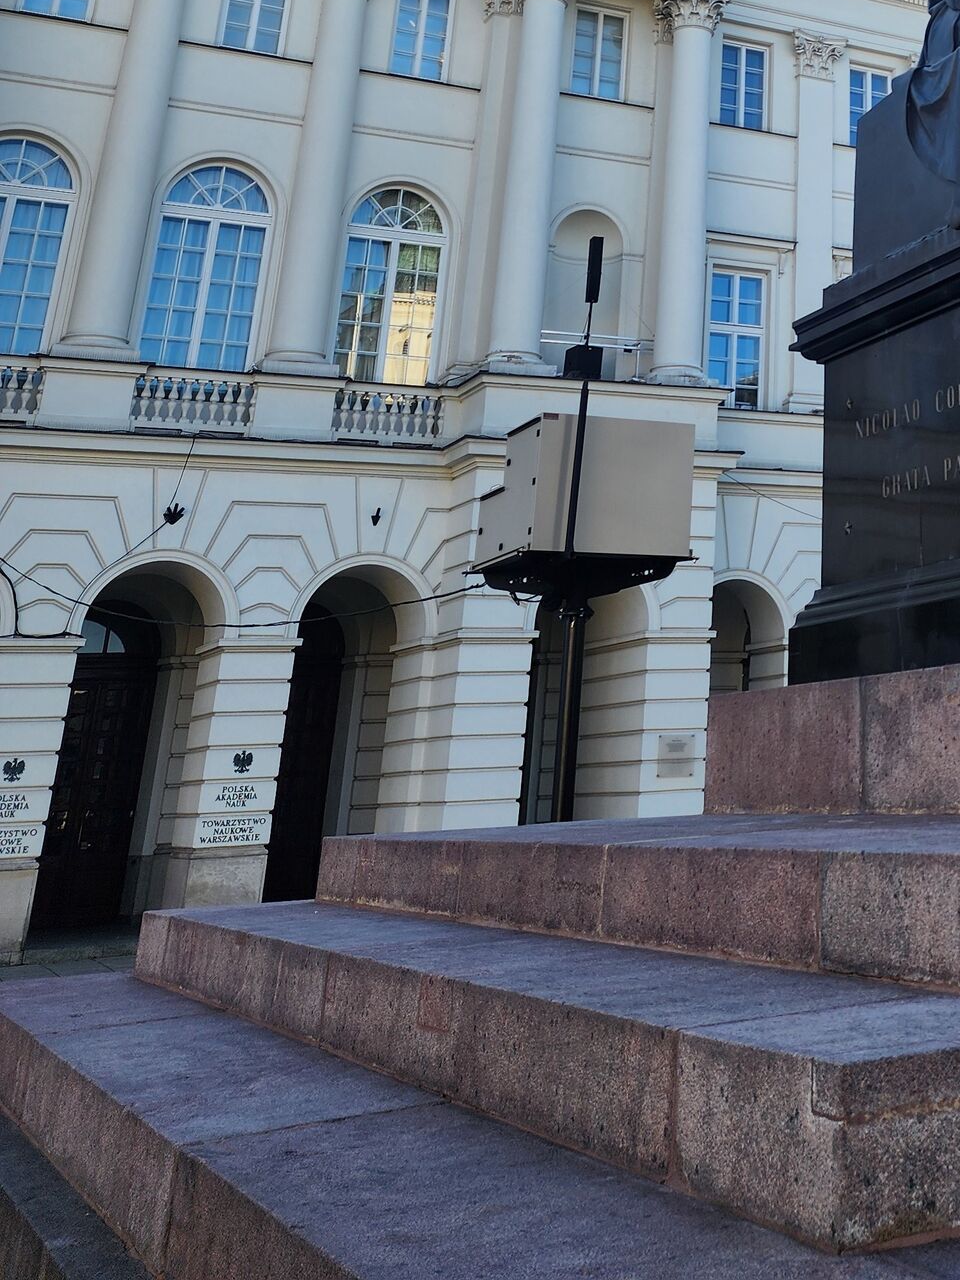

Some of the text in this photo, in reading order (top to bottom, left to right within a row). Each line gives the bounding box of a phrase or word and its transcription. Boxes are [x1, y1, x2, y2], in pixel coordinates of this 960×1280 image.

[882, 465, 931, 498] GRATA
[215, 793, 257, 801] AKADEMIA
[225, 800, 246, 808] NAUK
[202, 818, 266, 828] TOWARZYSTWO
[213, 827, 254, 835] NAUKOWE
[200, 834, 260, 843] WARSZAWSKIE
